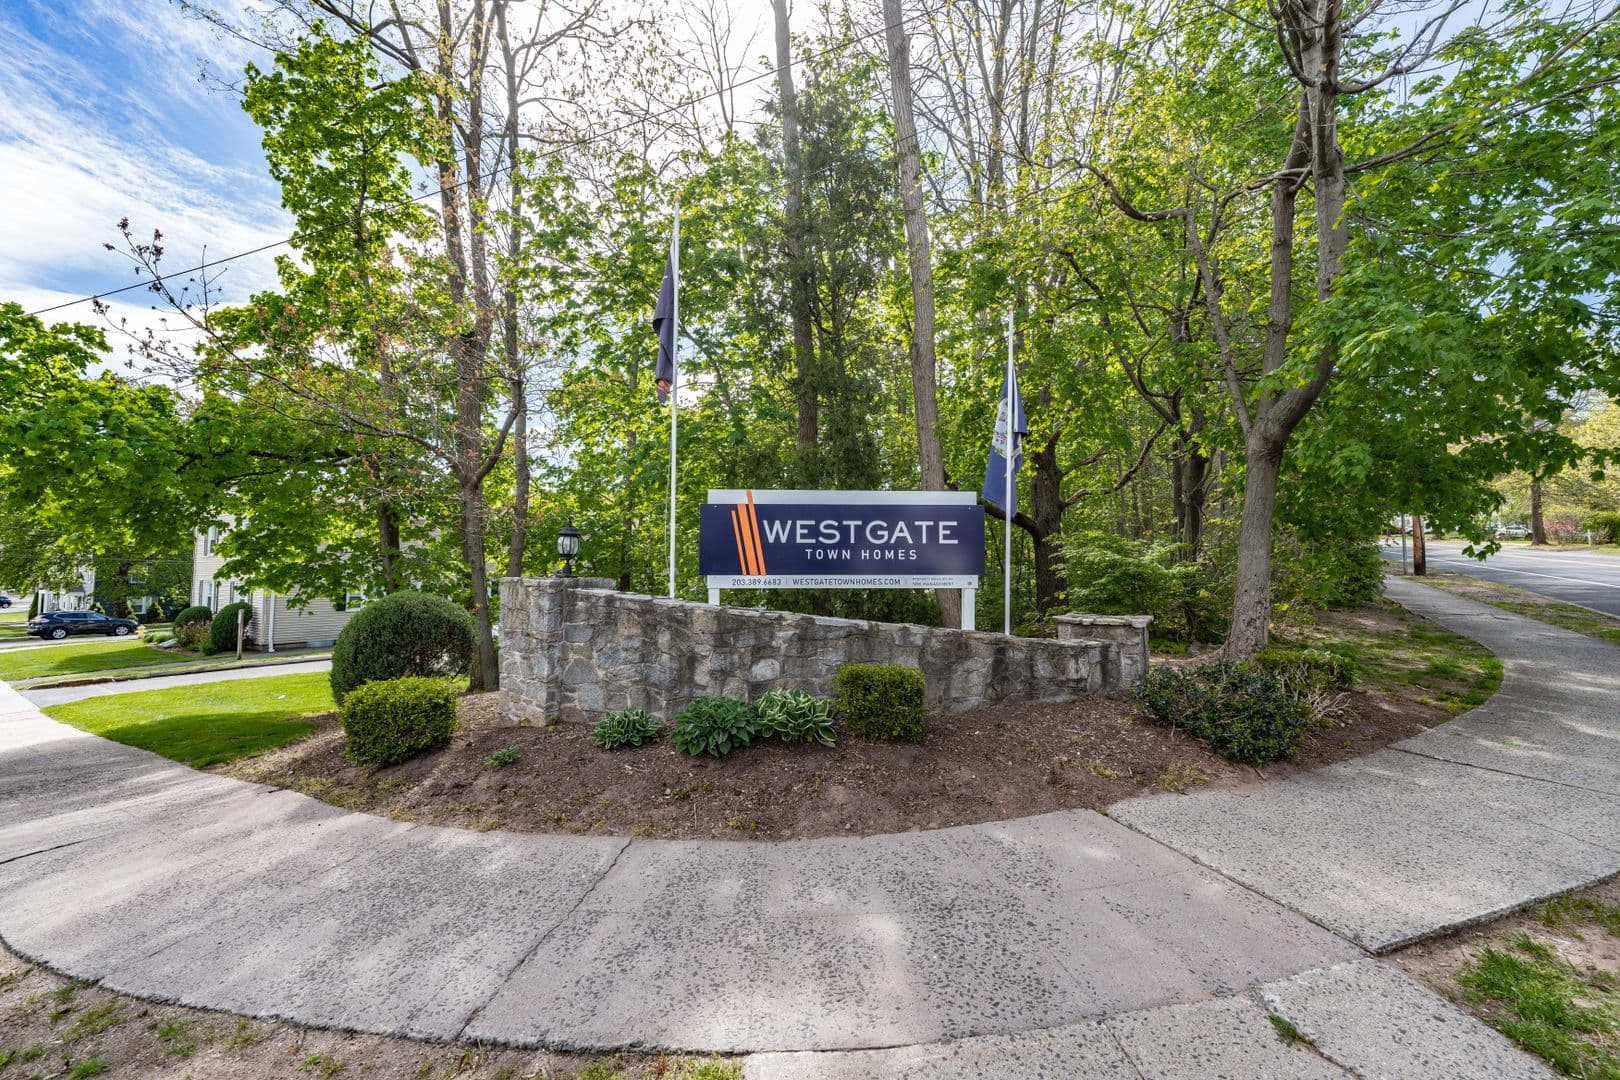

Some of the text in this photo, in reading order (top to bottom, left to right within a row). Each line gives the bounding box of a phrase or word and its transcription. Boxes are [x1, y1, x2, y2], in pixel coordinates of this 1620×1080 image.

[763, 520, 958, 544] WESTGATE
[805, 549, 917, 560] TOWN HOMES
[732, 578, 901, 586] 203.389.6683 WESTGATETOWNHOMES.COM
